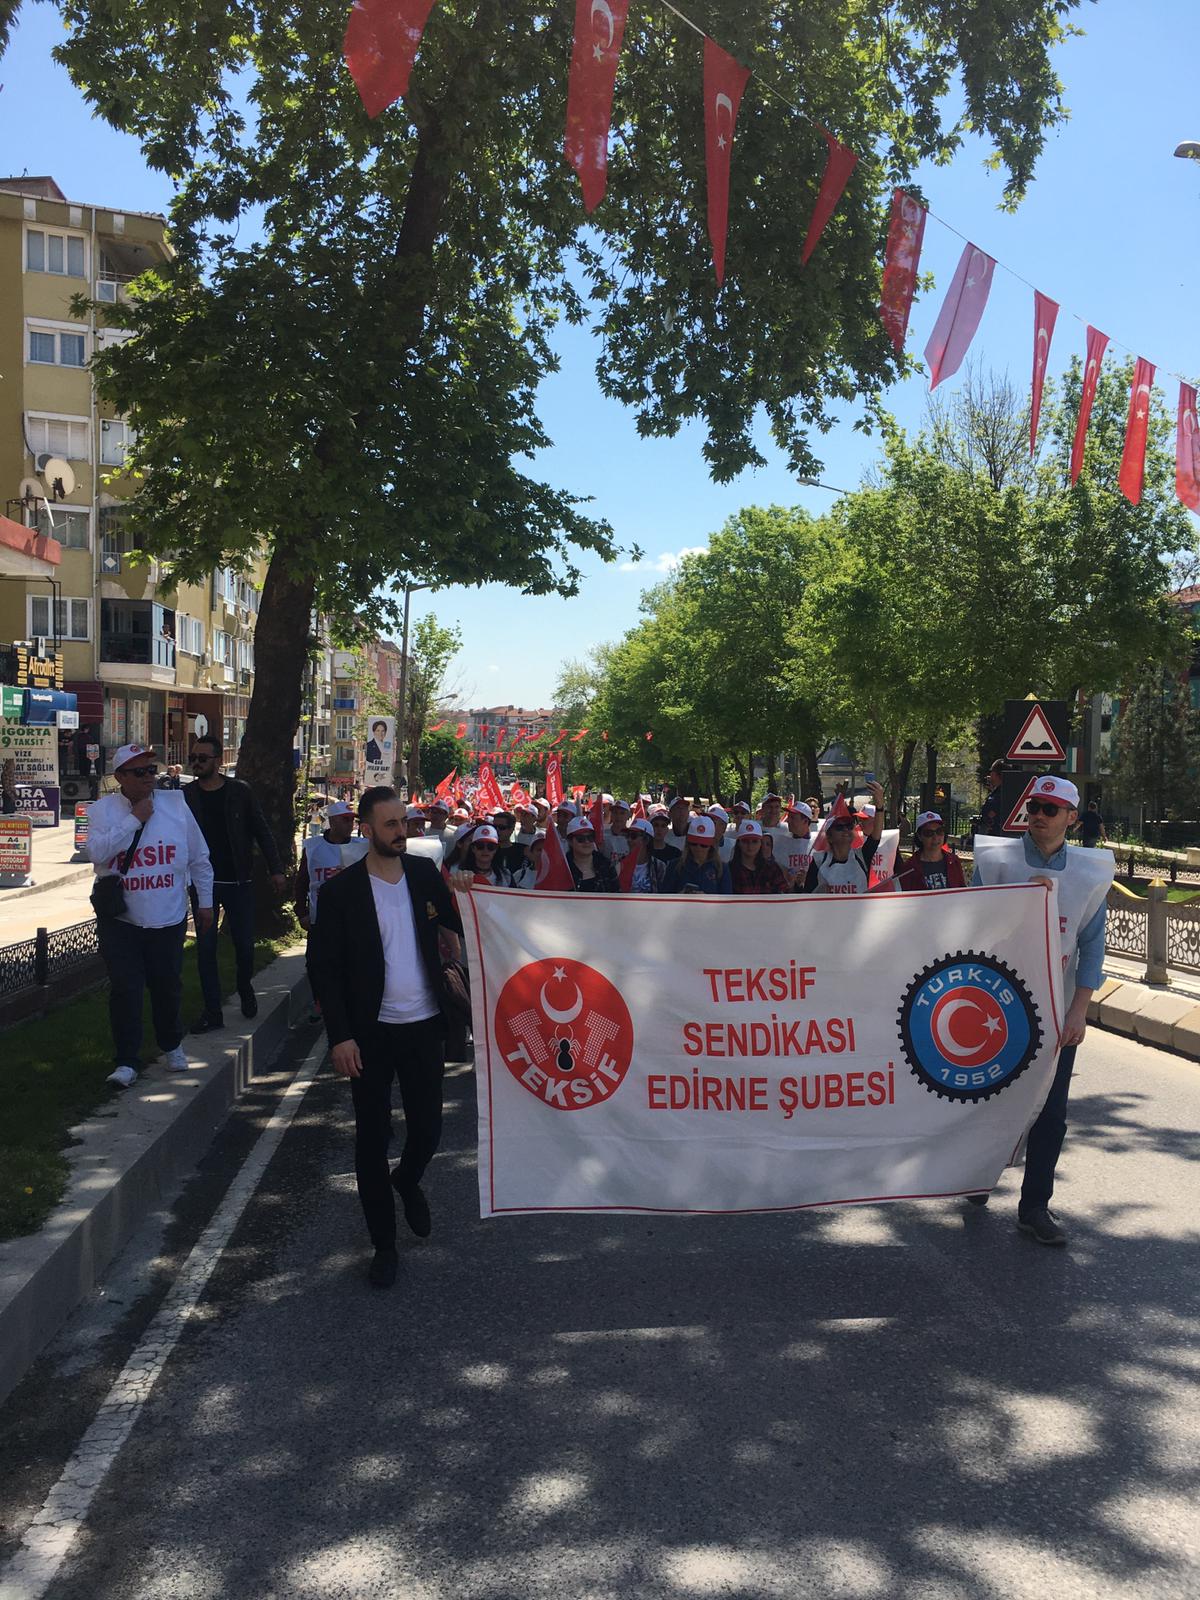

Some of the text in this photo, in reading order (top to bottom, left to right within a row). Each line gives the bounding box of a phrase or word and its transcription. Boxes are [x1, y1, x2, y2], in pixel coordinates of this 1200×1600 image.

[0, 725, 51, 736] İGORTA
[1, 736, 11, 747] 9
[121, 873, 175, 891] NDİKASI
[703, 959, 817, 1003] TEKSİF
[683, 1013, 856, 1057] SENDİKASI
[506, 1041, 621, 1107] TEKSİF
[647, 1061, 895, 1120] EDİRNE ŞUBESİ
[941, 1063, 1003, 1087] 1952
